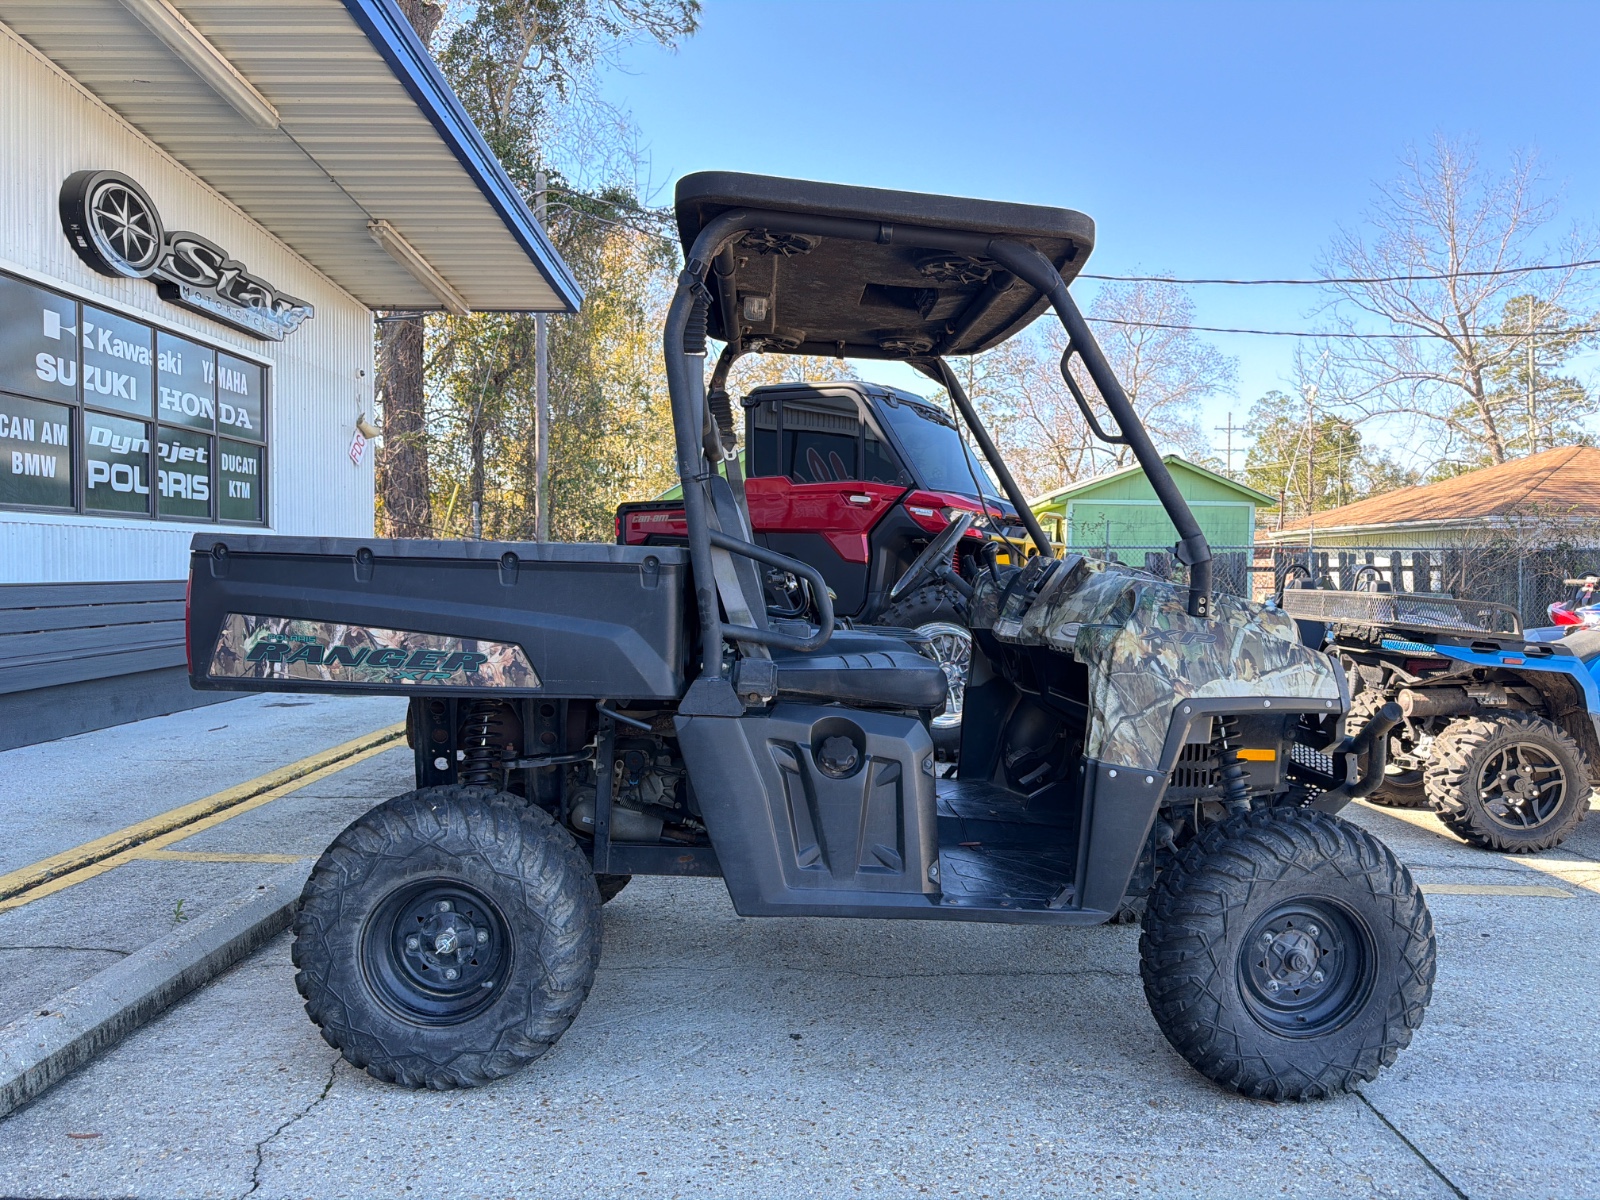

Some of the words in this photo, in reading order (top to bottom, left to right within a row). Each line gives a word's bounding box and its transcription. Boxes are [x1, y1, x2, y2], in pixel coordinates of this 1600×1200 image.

[160, 240, 305, 327] Star
[182, 285, 283, 337] MOTORCYCLES
[36, 352, 136, 400] SUZUKI
[202, 360, 248, 395] YAMAHA
[160, 386, 253, 429] HONDA
[0, 414, 34, 441] CAN
[41, 422, 68, 446] AM
[88, 426, 208, 464] Dynojet
[350, 434, 365, 462] FDC
[12, 451, 56, 478] BMW
[222, 453, 257, 475] DUCATI
[229, 480, 250, 499] KTM
[632, 514, 669, 523] can-am
[268, 633, 317, 643] POLARIS
[1141, 627, 1217, 645] XP
[246, 641, 488, 673] RANGER
[394, 671, 452, 681] XP
